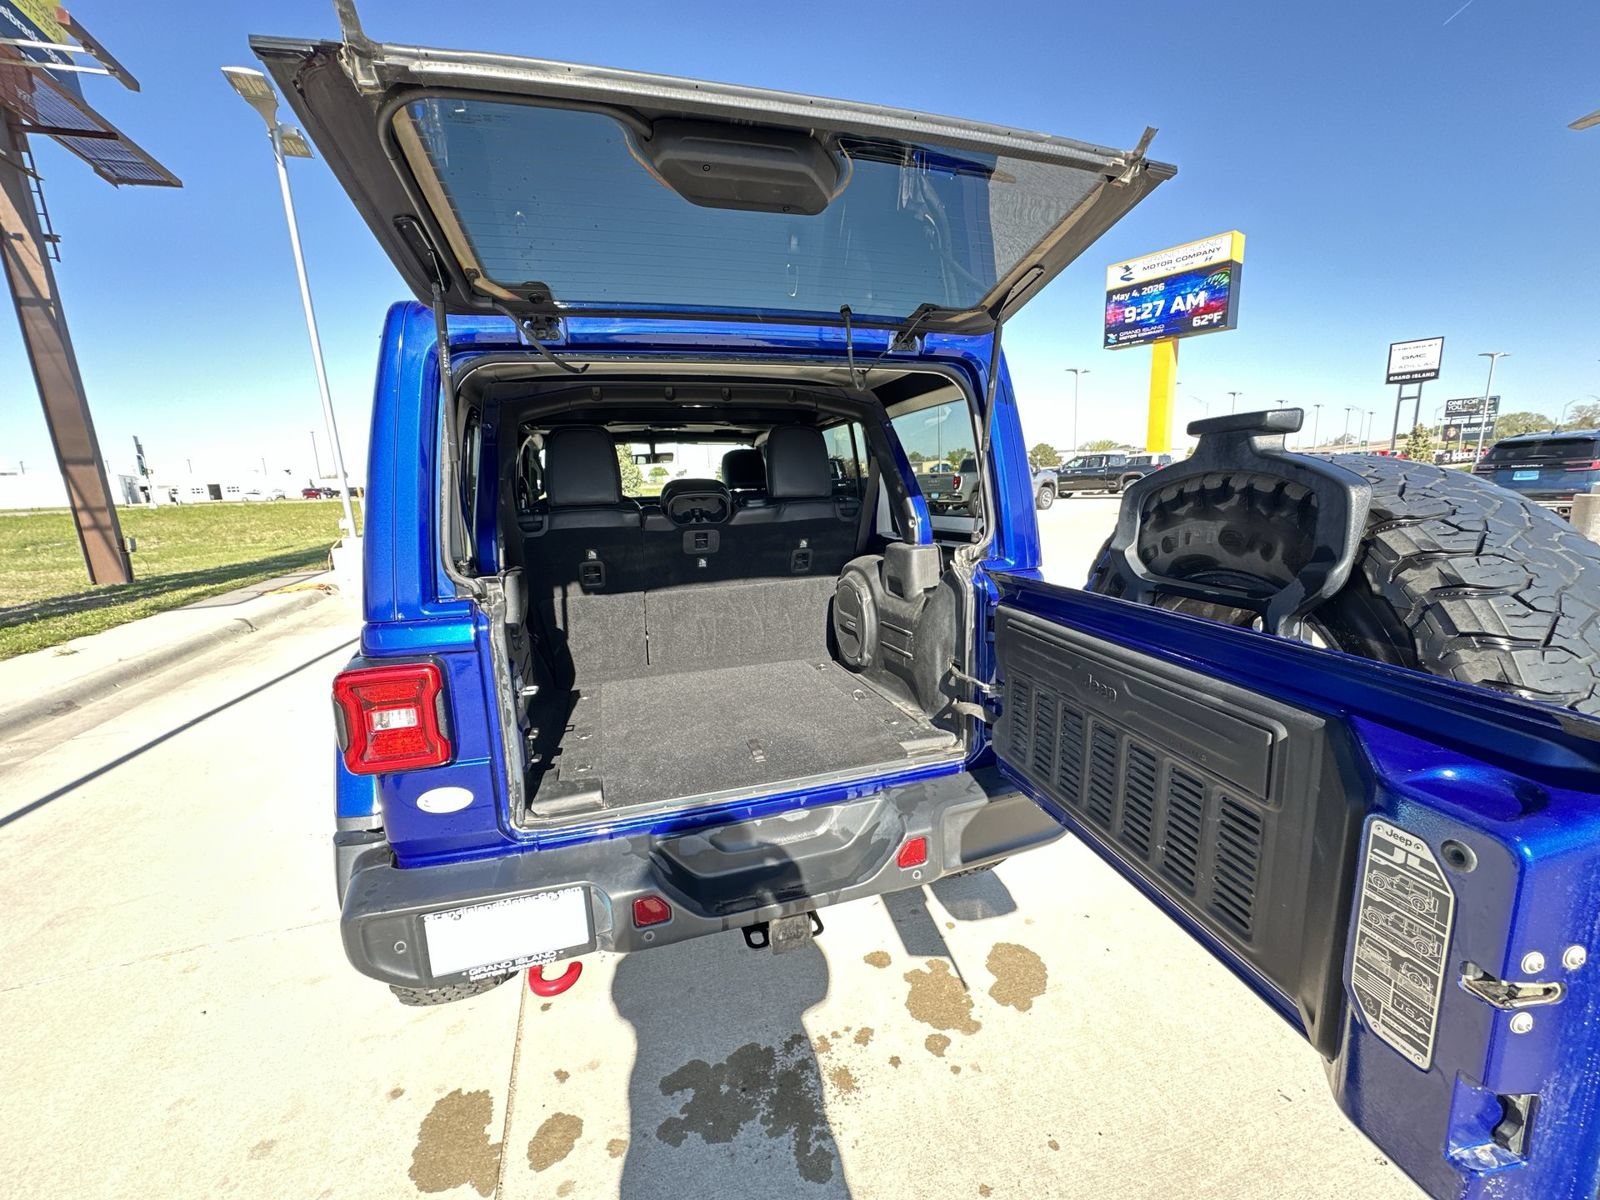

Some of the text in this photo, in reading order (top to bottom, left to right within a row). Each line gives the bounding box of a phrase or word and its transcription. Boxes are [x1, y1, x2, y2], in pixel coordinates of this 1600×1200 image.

[1142, 246, 1222, 271] MOTOR COMPANY
[1112, 283, 1165, 303] May 4, 2026
[1124, 290, 1206, 323] 9:27 AM
[1119, 324, 1165, 337] GRAND ISLAND
[1411, 371, 1435, 379] ISLAND
[1385, 829, 1413, 847] Jeep
[1372, 846, 1440, 881] JL
[468, 950, 557, 976] GRAND ISLAND
